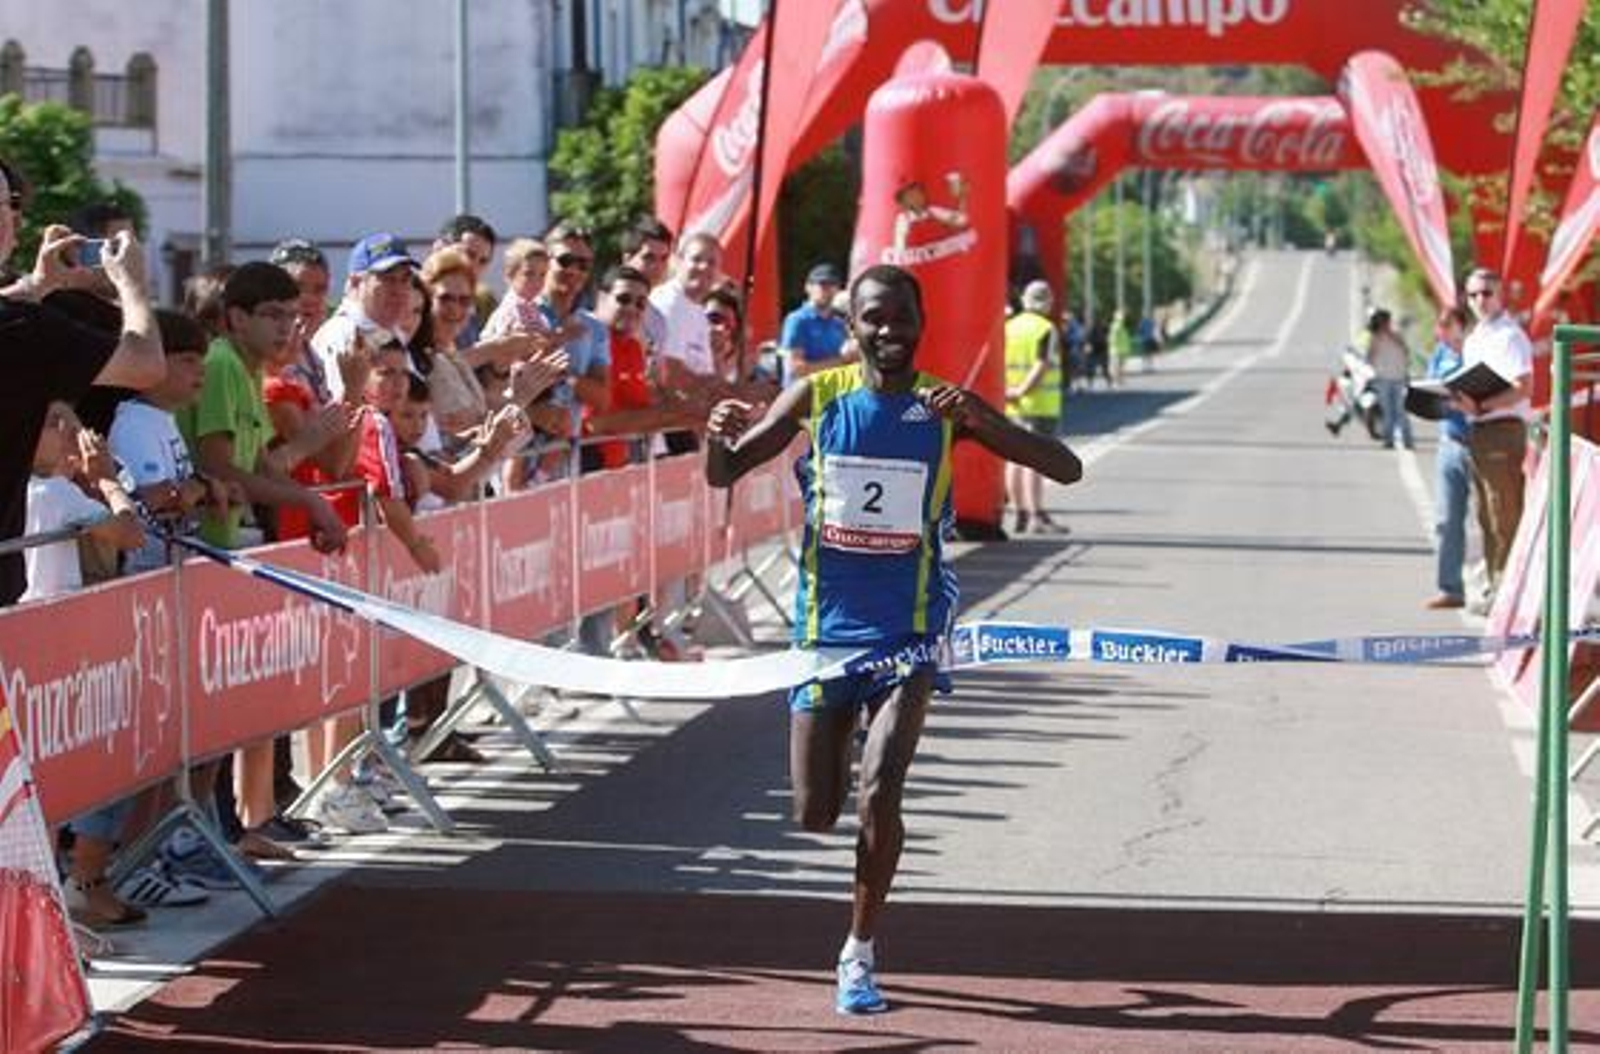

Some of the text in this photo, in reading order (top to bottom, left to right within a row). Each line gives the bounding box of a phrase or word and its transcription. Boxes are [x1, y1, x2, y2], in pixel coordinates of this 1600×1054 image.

[927, 0, 1287, 37] Ccampo
[862, 481, 884, 514] 2
[199, 602, 321, 695] Cruzcampo
[1101, 640, 1189, 662] Buckler
[8, 656, 132, 764] Cruzcampo
